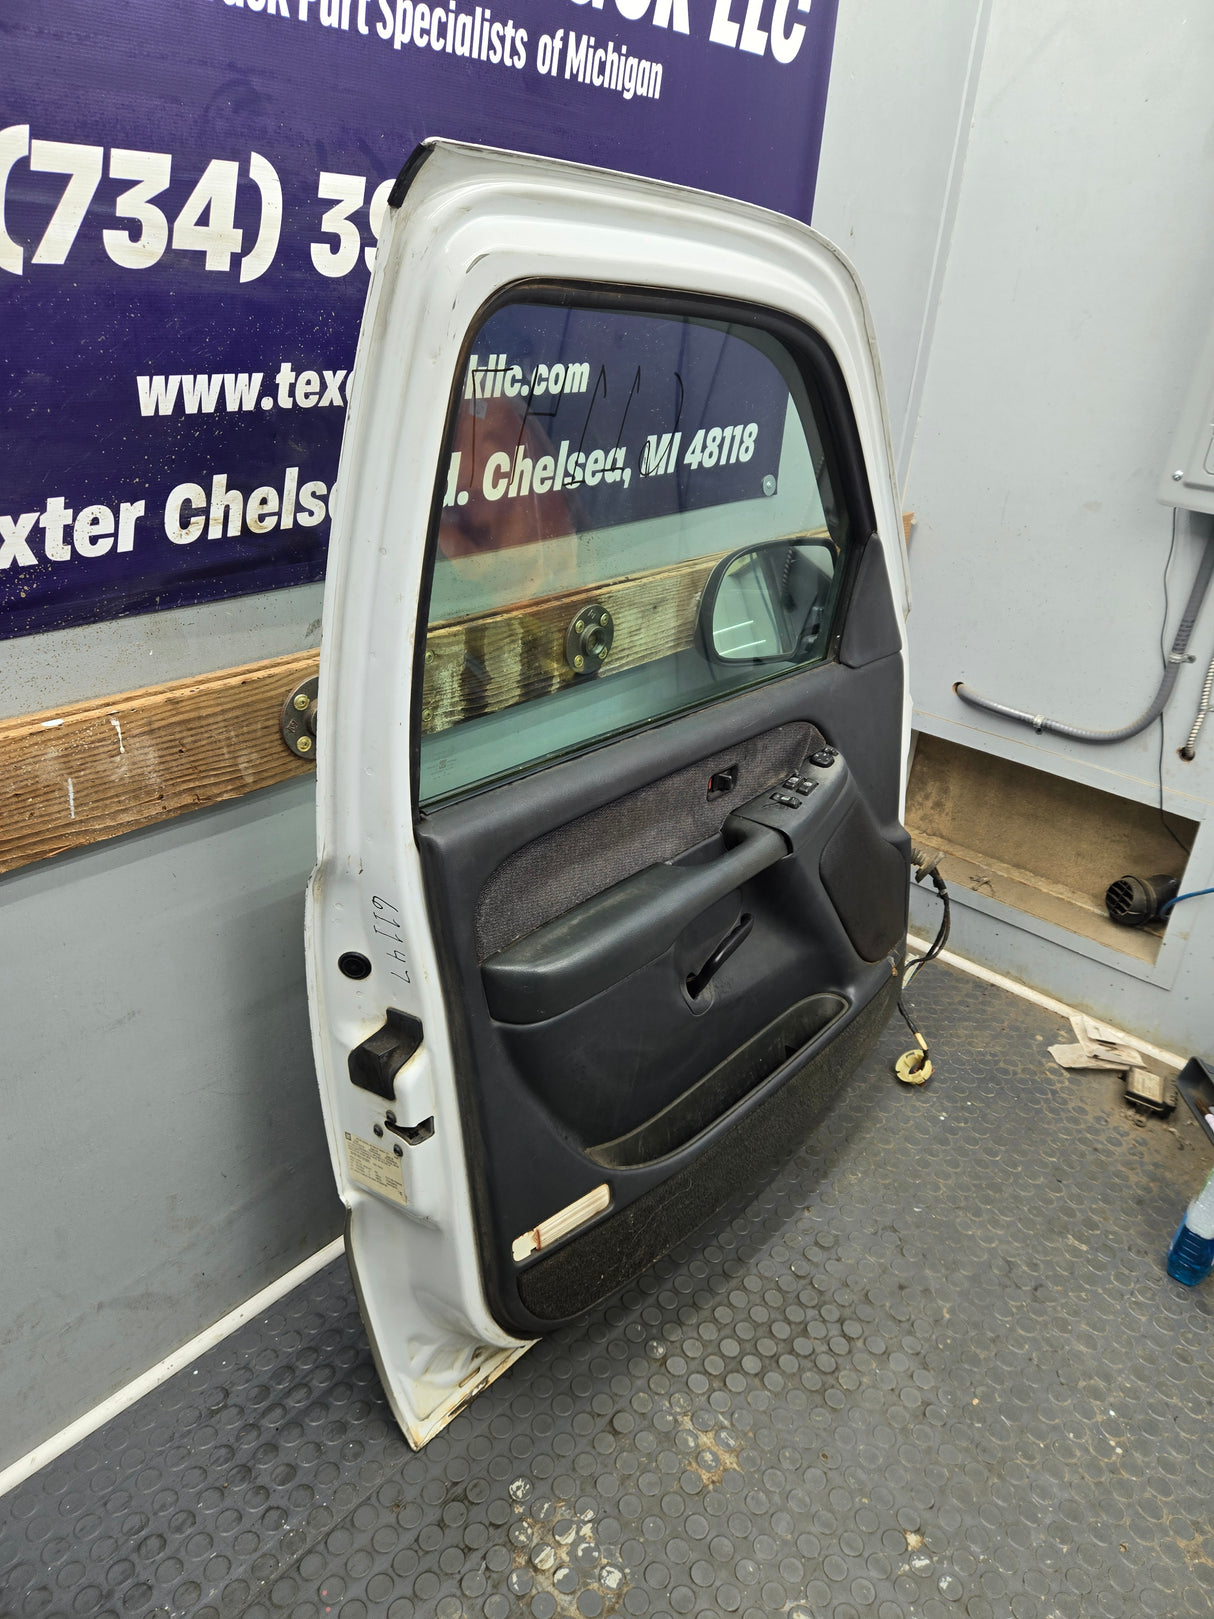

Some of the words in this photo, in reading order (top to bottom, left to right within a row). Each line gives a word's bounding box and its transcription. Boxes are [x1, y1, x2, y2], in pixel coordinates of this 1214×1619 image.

[375, 0, 528, 70] Specialists
[536, 28, 564, 77] of
[565, 31, 664, 100] Michigan
[708, 0, 812, 64] LLC
[0, 124, 283, 283] (734)
[136, 362, 355, 417] www.tex
[0, 496, 145, 570] xter
[164, 467, 338, 545] Chels
[482, 440, 632, 501] Chelsea,
[640, 432, 682, 478] MI
[683, 422, 759, 470] 48118
[372, 895, 411, 984] 61147
